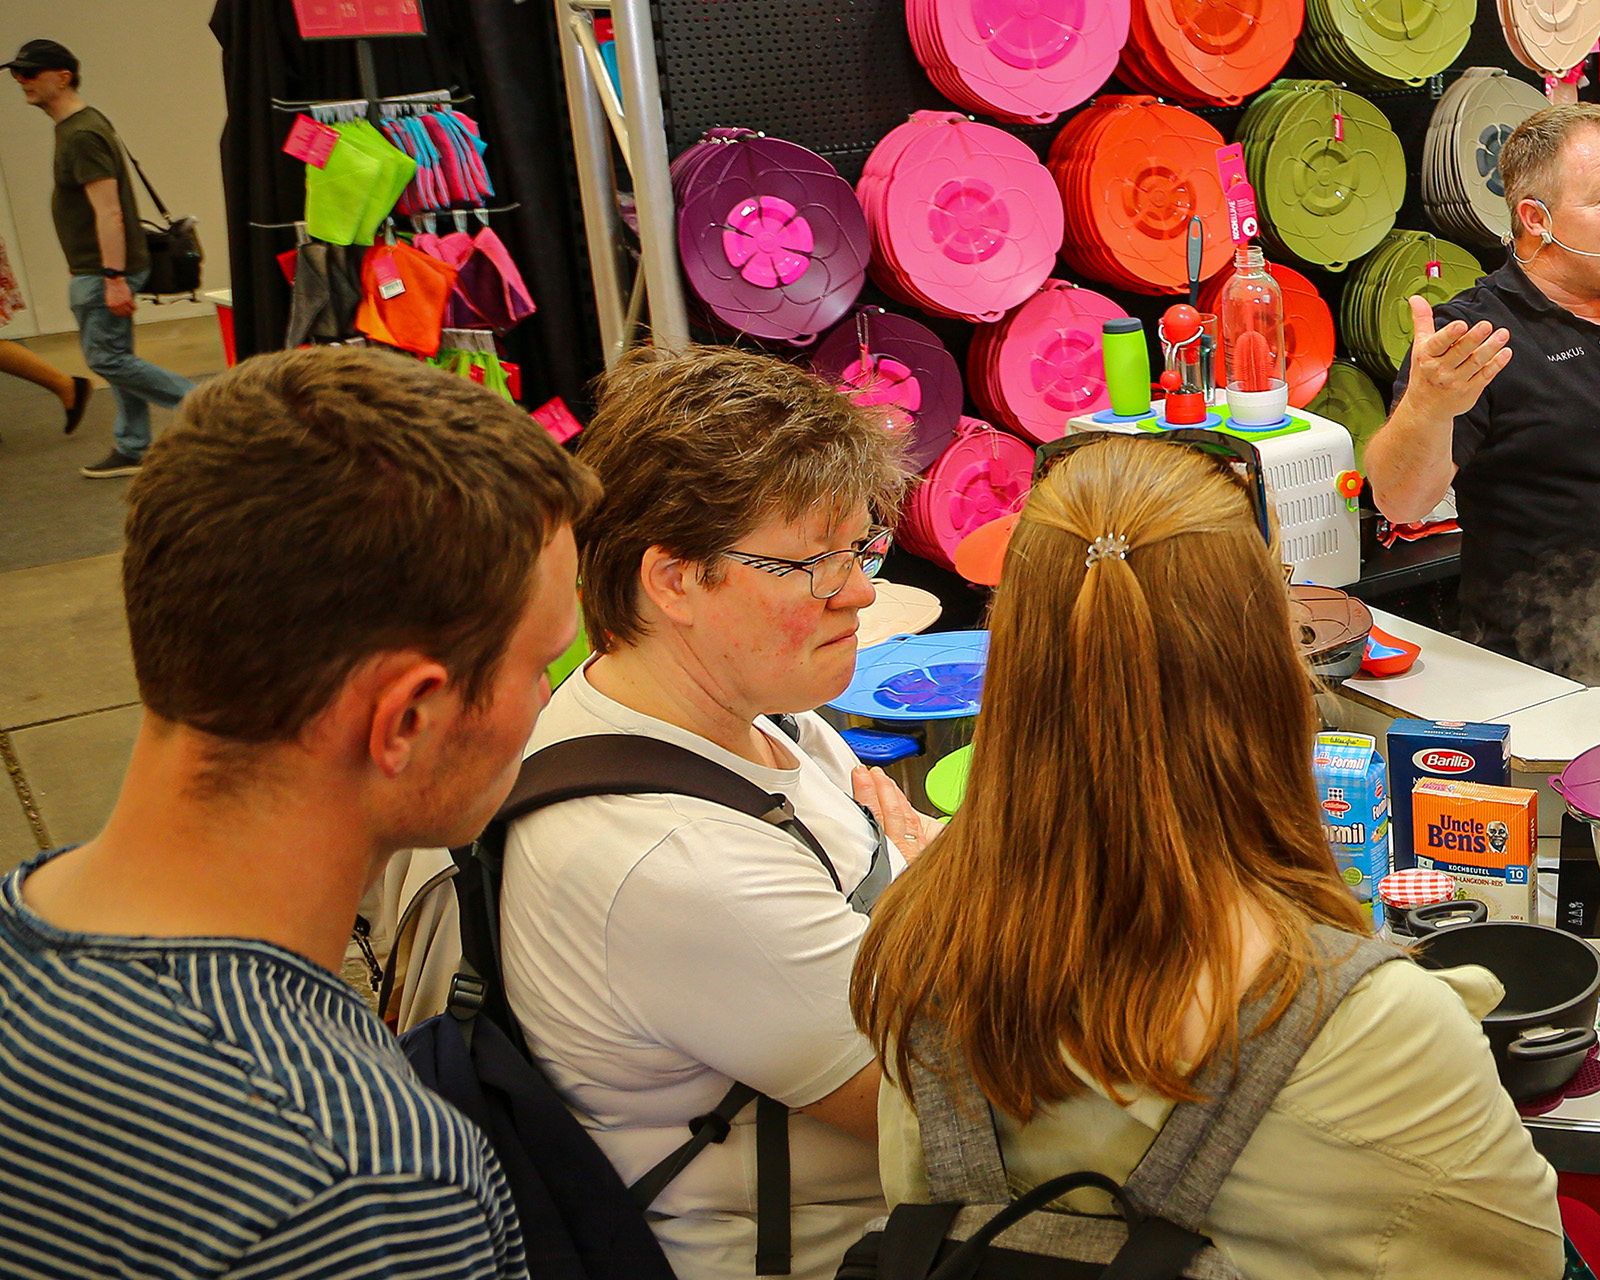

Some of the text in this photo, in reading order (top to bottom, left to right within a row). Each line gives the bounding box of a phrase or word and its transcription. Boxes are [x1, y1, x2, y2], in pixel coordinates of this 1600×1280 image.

[1547, 346, 1585, 362] MARKUS
[1330, 755, 1365, 770] Formil
[1427, 754, 1469, 768] Barilla
[1440, 814, 1484, 835] Uncle
[1321, 822, 1365, 844] ormil
[1427, 823, 1486, 854] Ben's
[1448, 864, 1490, 875] KOCHBEUTEL
[1510, 870, 1524, 879] 10
